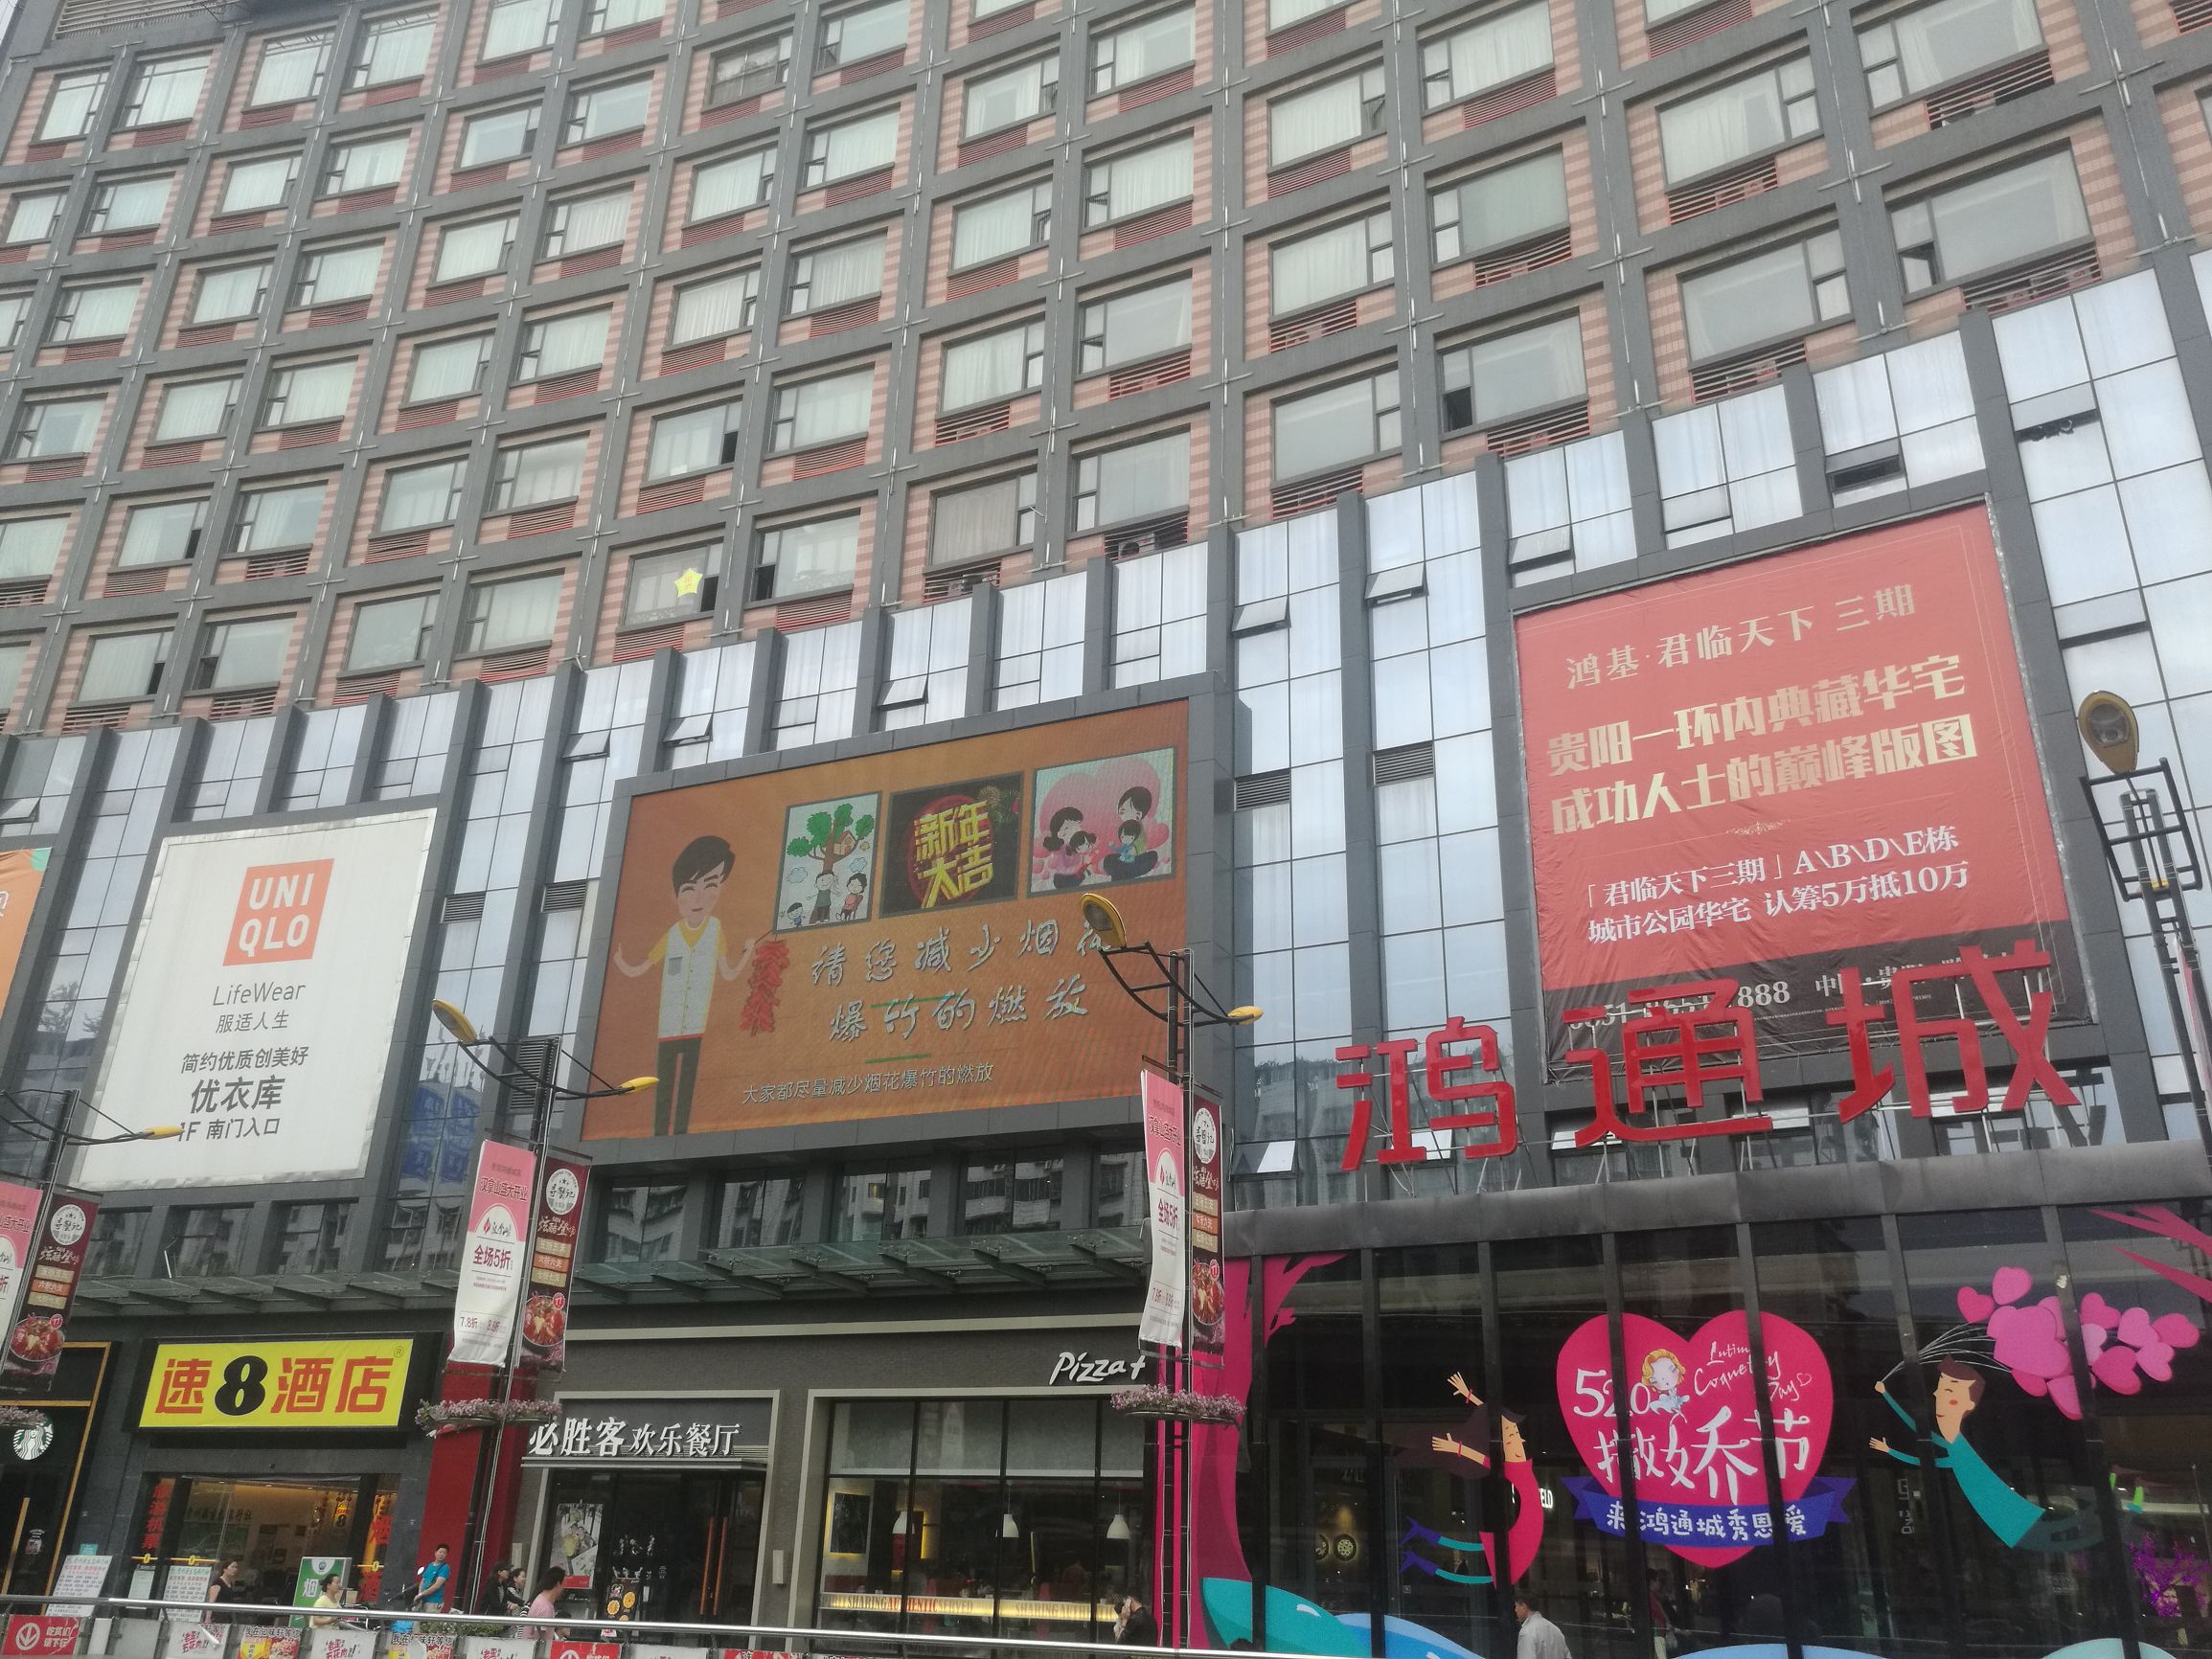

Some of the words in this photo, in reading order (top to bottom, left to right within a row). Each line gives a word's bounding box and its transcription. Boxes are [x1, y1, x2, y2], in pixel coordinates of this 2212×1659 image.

[1566, 607, 1815, 690] 鸿基·君临天下
[1836, 583, 1916, 632] 三期
[1546, 654, 1966, 778] 贵阳一环内典藏华宅
[1551, 714, 1977, 835] 成功人士的巅峰版图
[249, 873, 313, 911] UNI
[1587, 897, 1752, 943] 城市公园华宅
[1764, 861, 1969, 920] 认筹5万抵10万
[239, 914, 310, 956] QLO
[213, 982, 306, 1006] LifeWear
[215, 1011, 289, 1034] 服适人生
[180, 1046, 308, 1075] 简约优质创美好
[1335, 941, 2079, 1171] 鸿通城
[190, 1075, 285, 1114] 优衣库
[742, 1061, 993, 1105] 大家都尽量减少烟花爆竹的燃放
[206, 1118, 280, 1140] 南门入口
[473, 1243, 513, 1269] 全场5折
[154, 1355, 392, 1416] 速8酒店
[1049, 1352, 1127, 1386] Pizza
[1607, 1500, 1807, 1541] 来鸿通城秀恩爱
